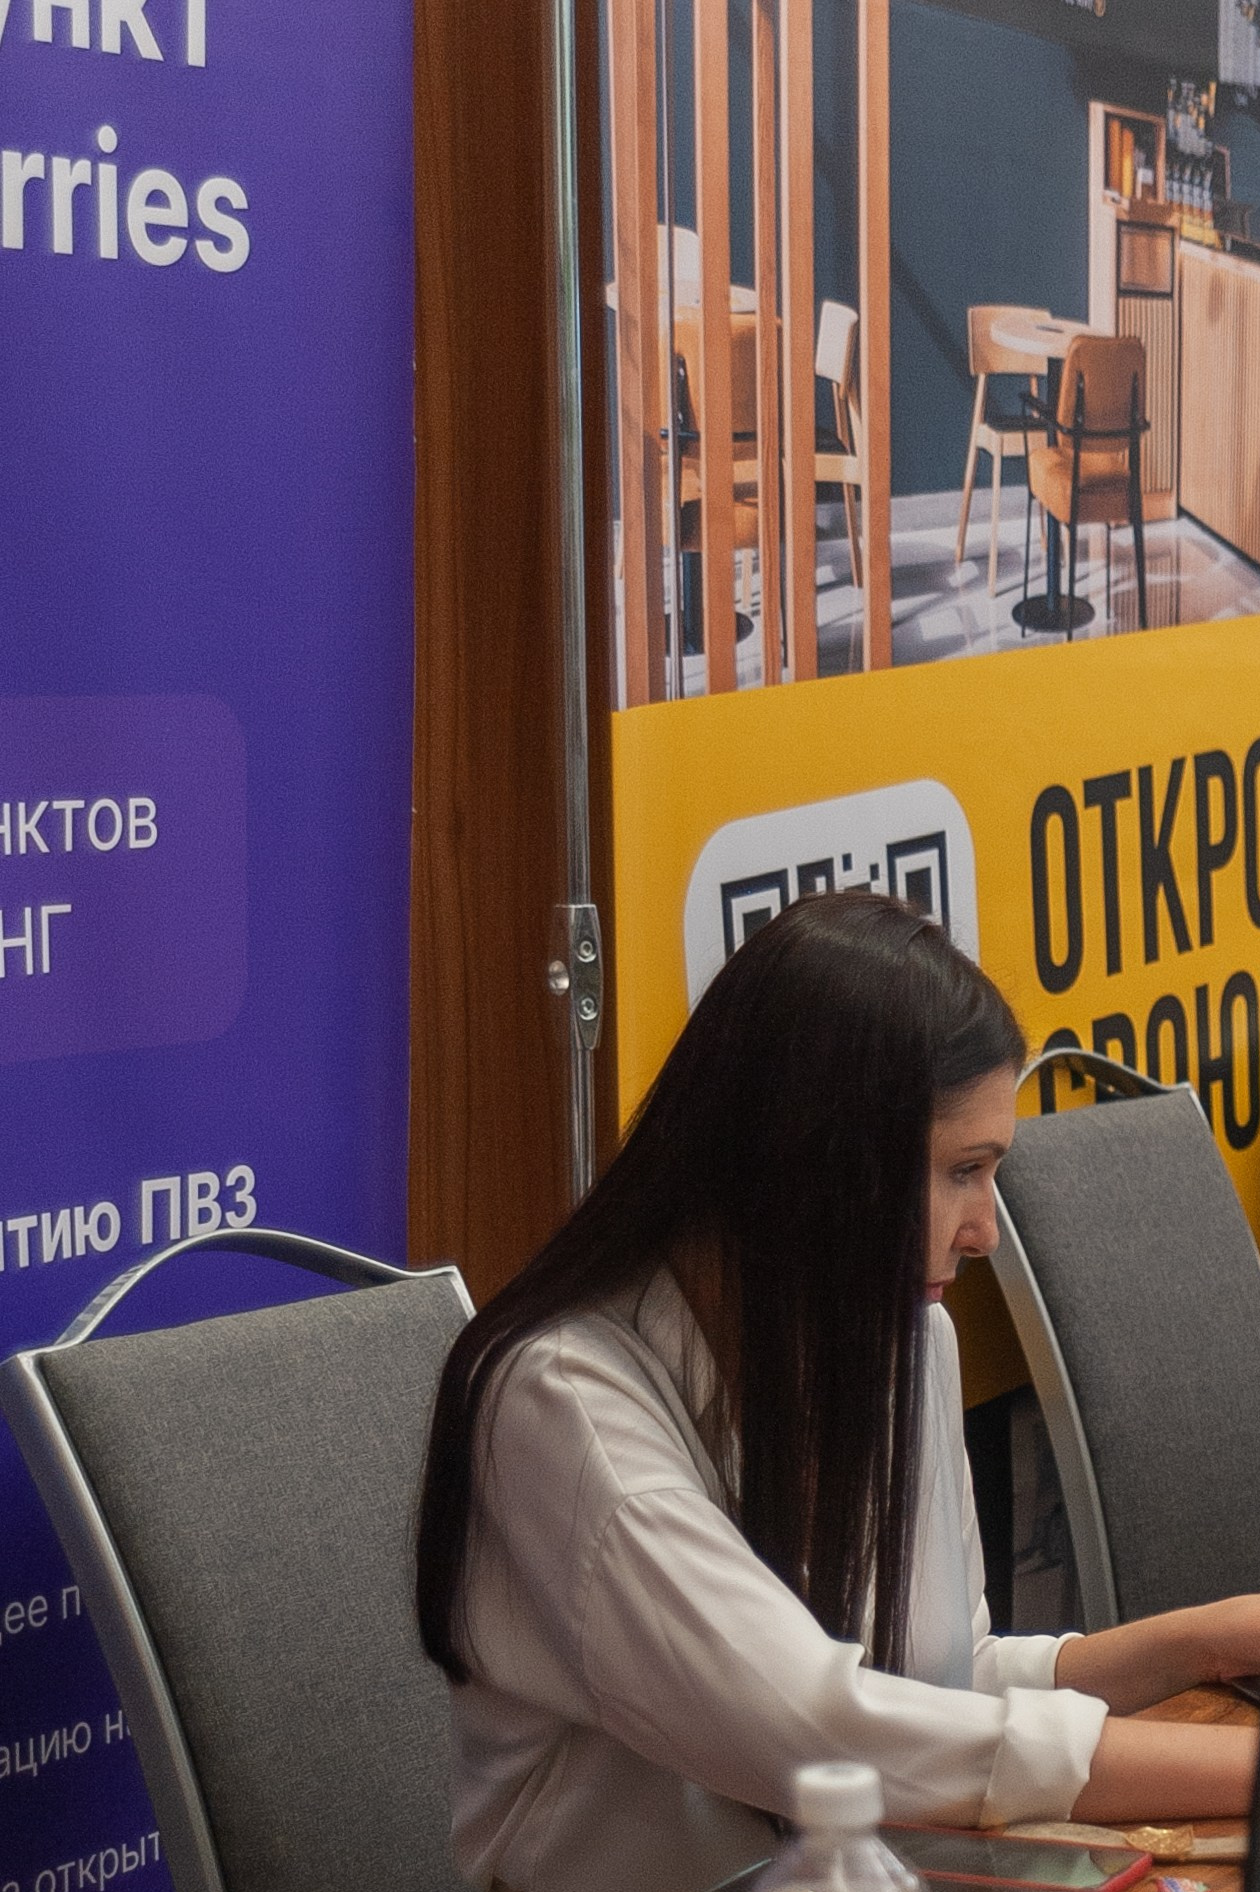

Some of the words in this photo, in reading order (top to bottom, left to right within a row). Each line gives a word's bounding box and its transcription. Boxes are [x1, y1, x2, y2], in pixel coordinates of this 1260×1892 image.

[0, 1201, 121, 1272] ТИЮ
[141, 1164, 257, 1245] ПВЗ
[0, 1595, 48, 1646] ее
[105, 1710, 131, 1744] н
